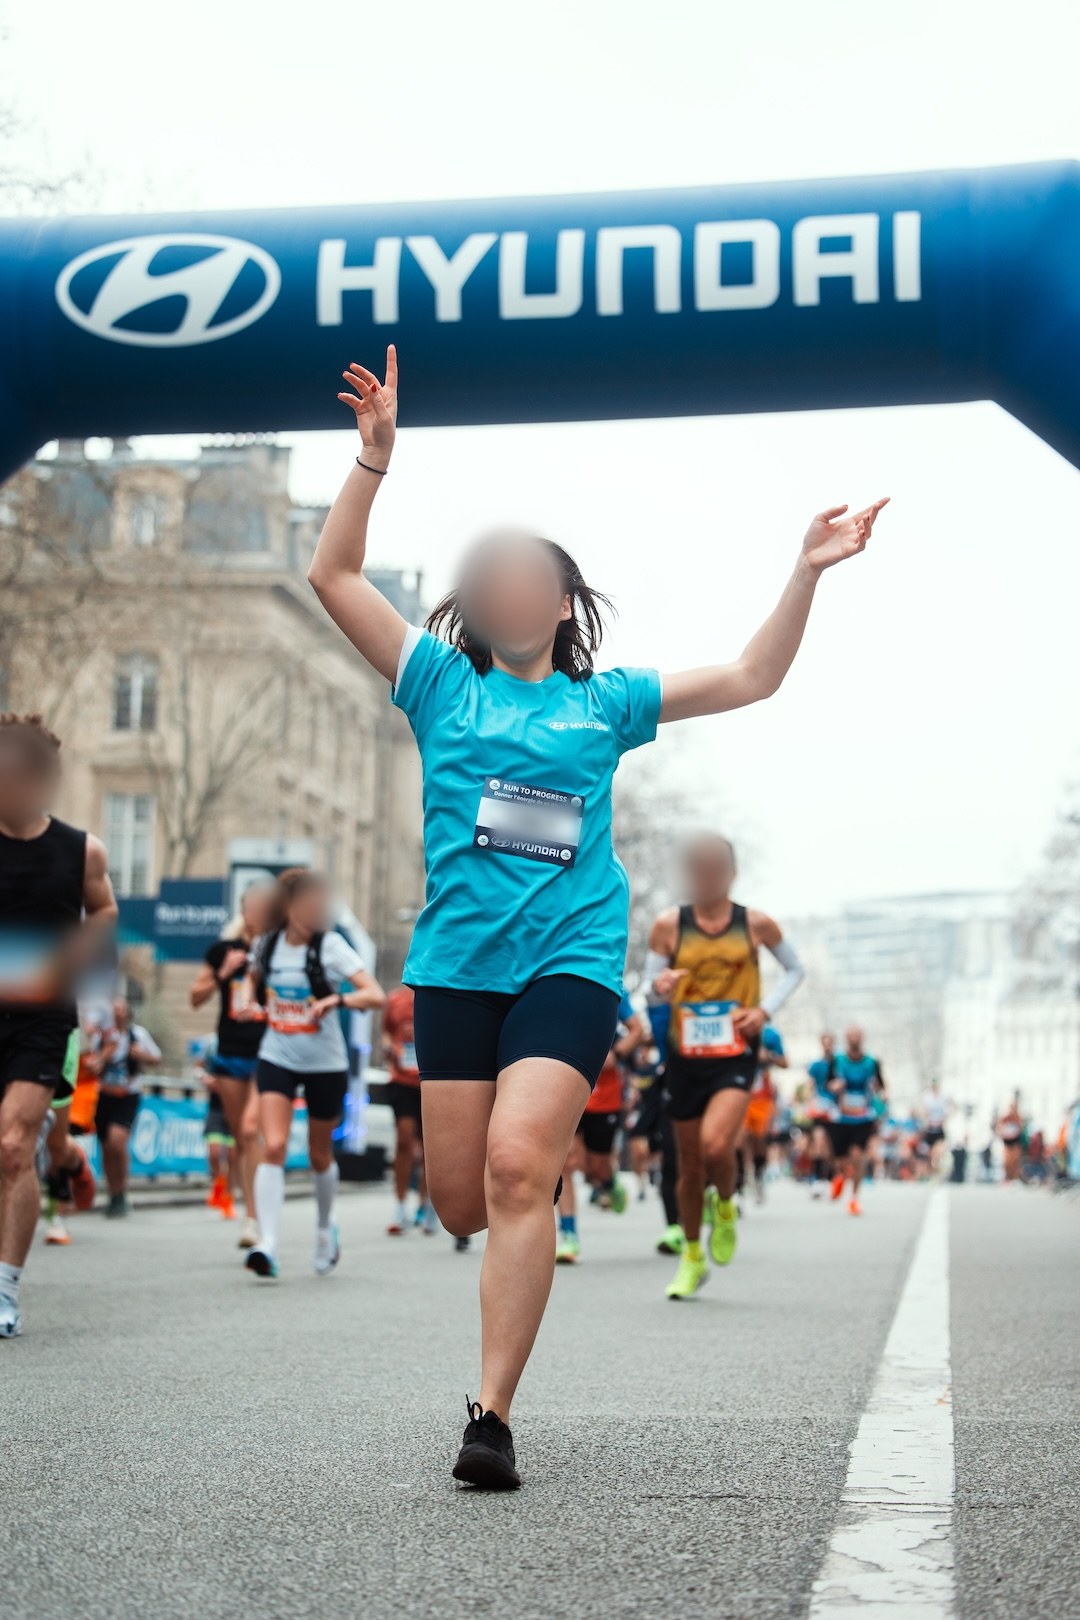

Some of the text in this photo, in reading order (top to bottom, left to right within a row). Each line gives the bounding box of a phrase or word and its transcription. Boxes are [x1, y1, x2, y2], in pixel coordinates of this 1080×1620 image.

[316, 210, 921, 326] HYUNDAI
[493, 790, 514, 799] Donner
[503, 783, 520, 793] RUN
[520, 787, 531, 795] TO
[532, 789, 568, 803] PROGRESS
[512, 841, 560, 858] HYUNDAI
